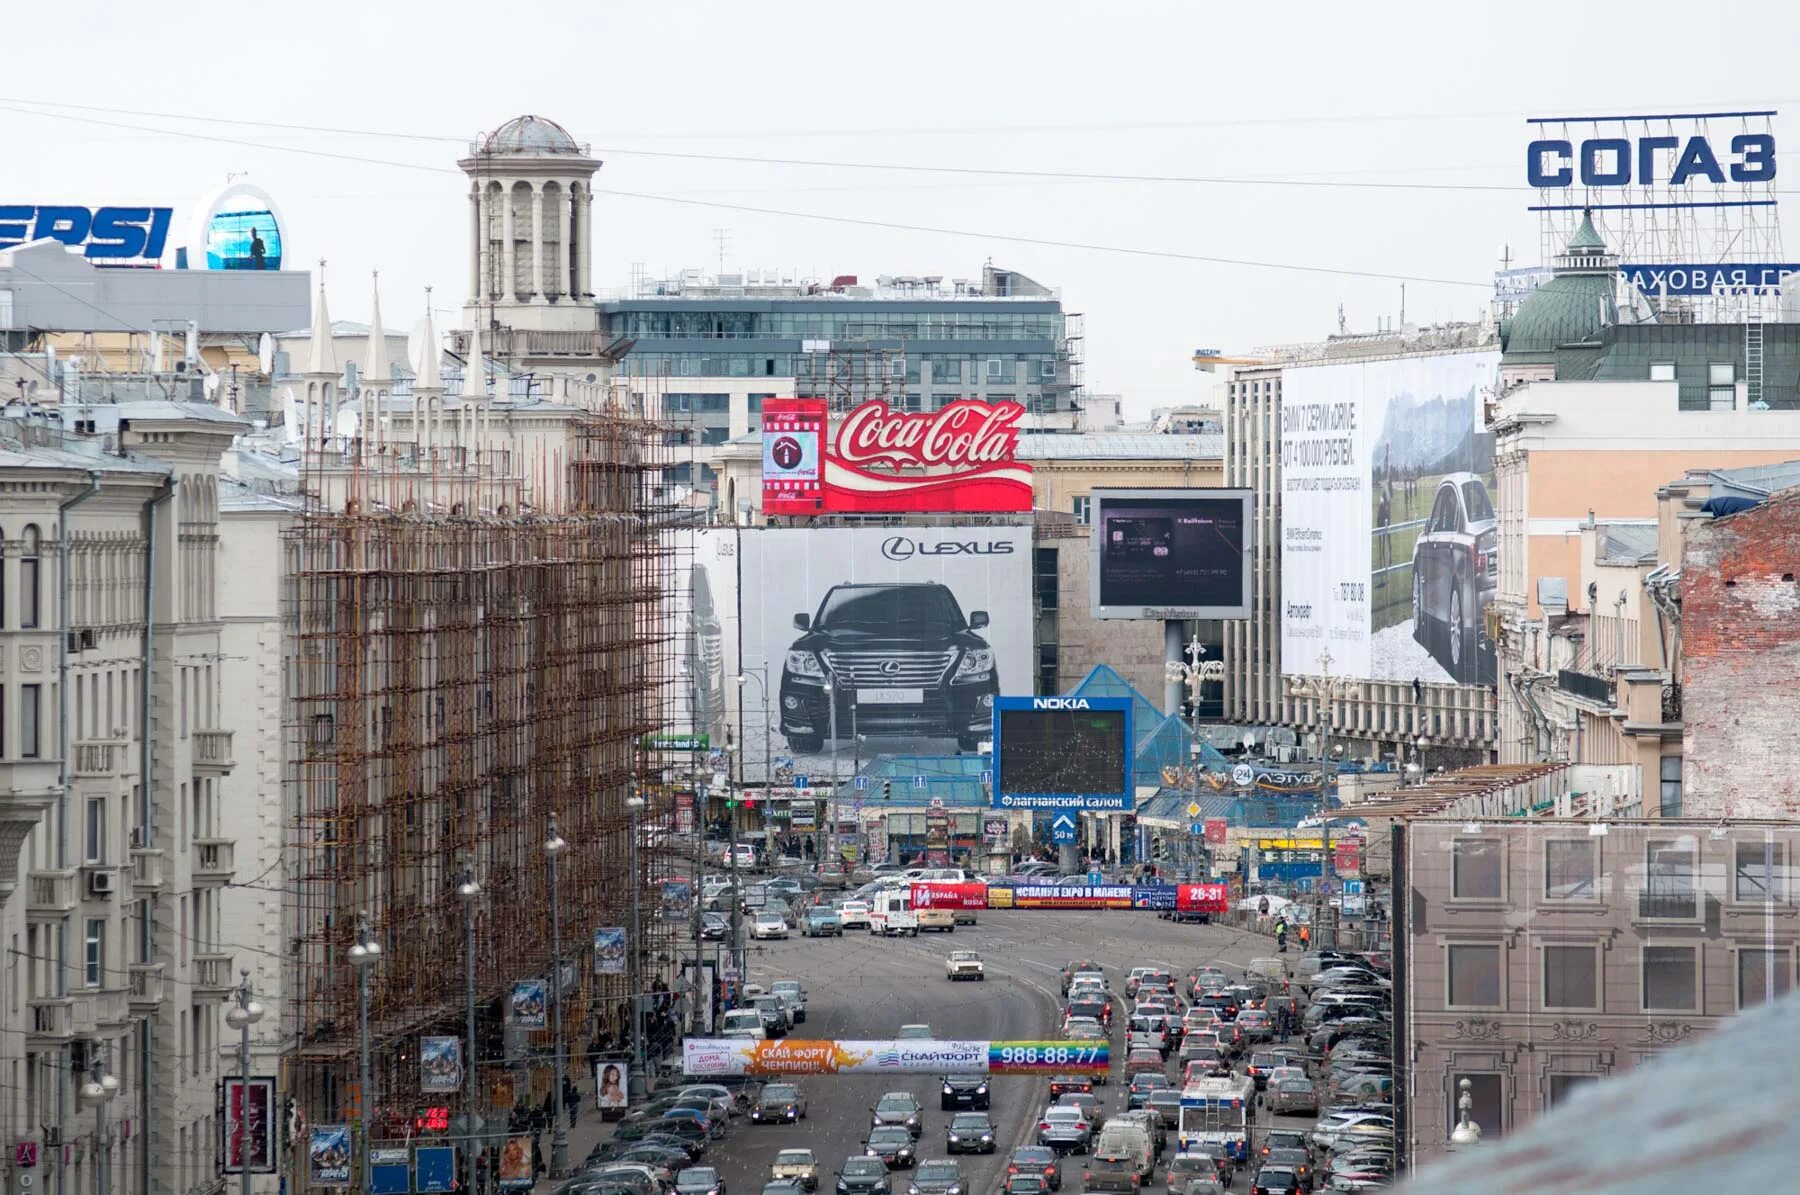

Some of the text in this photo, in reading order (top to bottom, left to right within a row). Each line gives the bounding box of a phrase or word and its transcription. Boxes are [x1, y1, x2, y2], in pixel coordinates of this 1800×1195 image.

[1527, 134, 1777, 187] СОГАЗ
[918, 541, 1014, 555] LEXUS
[1033, 698, 1090, 709] NOKIA
[1236, 769, 1250, 780] 24
[1002, 795, 1123, 808] Флагманский салон
[1054, 831, 1065, 839] 50
[698, 1054, 720, 1063] ДОМА
[761, 1046, 825, 1059] СКАЙ ФОРТ
[1001, 1047, 1098, 1064] 988-88-77
